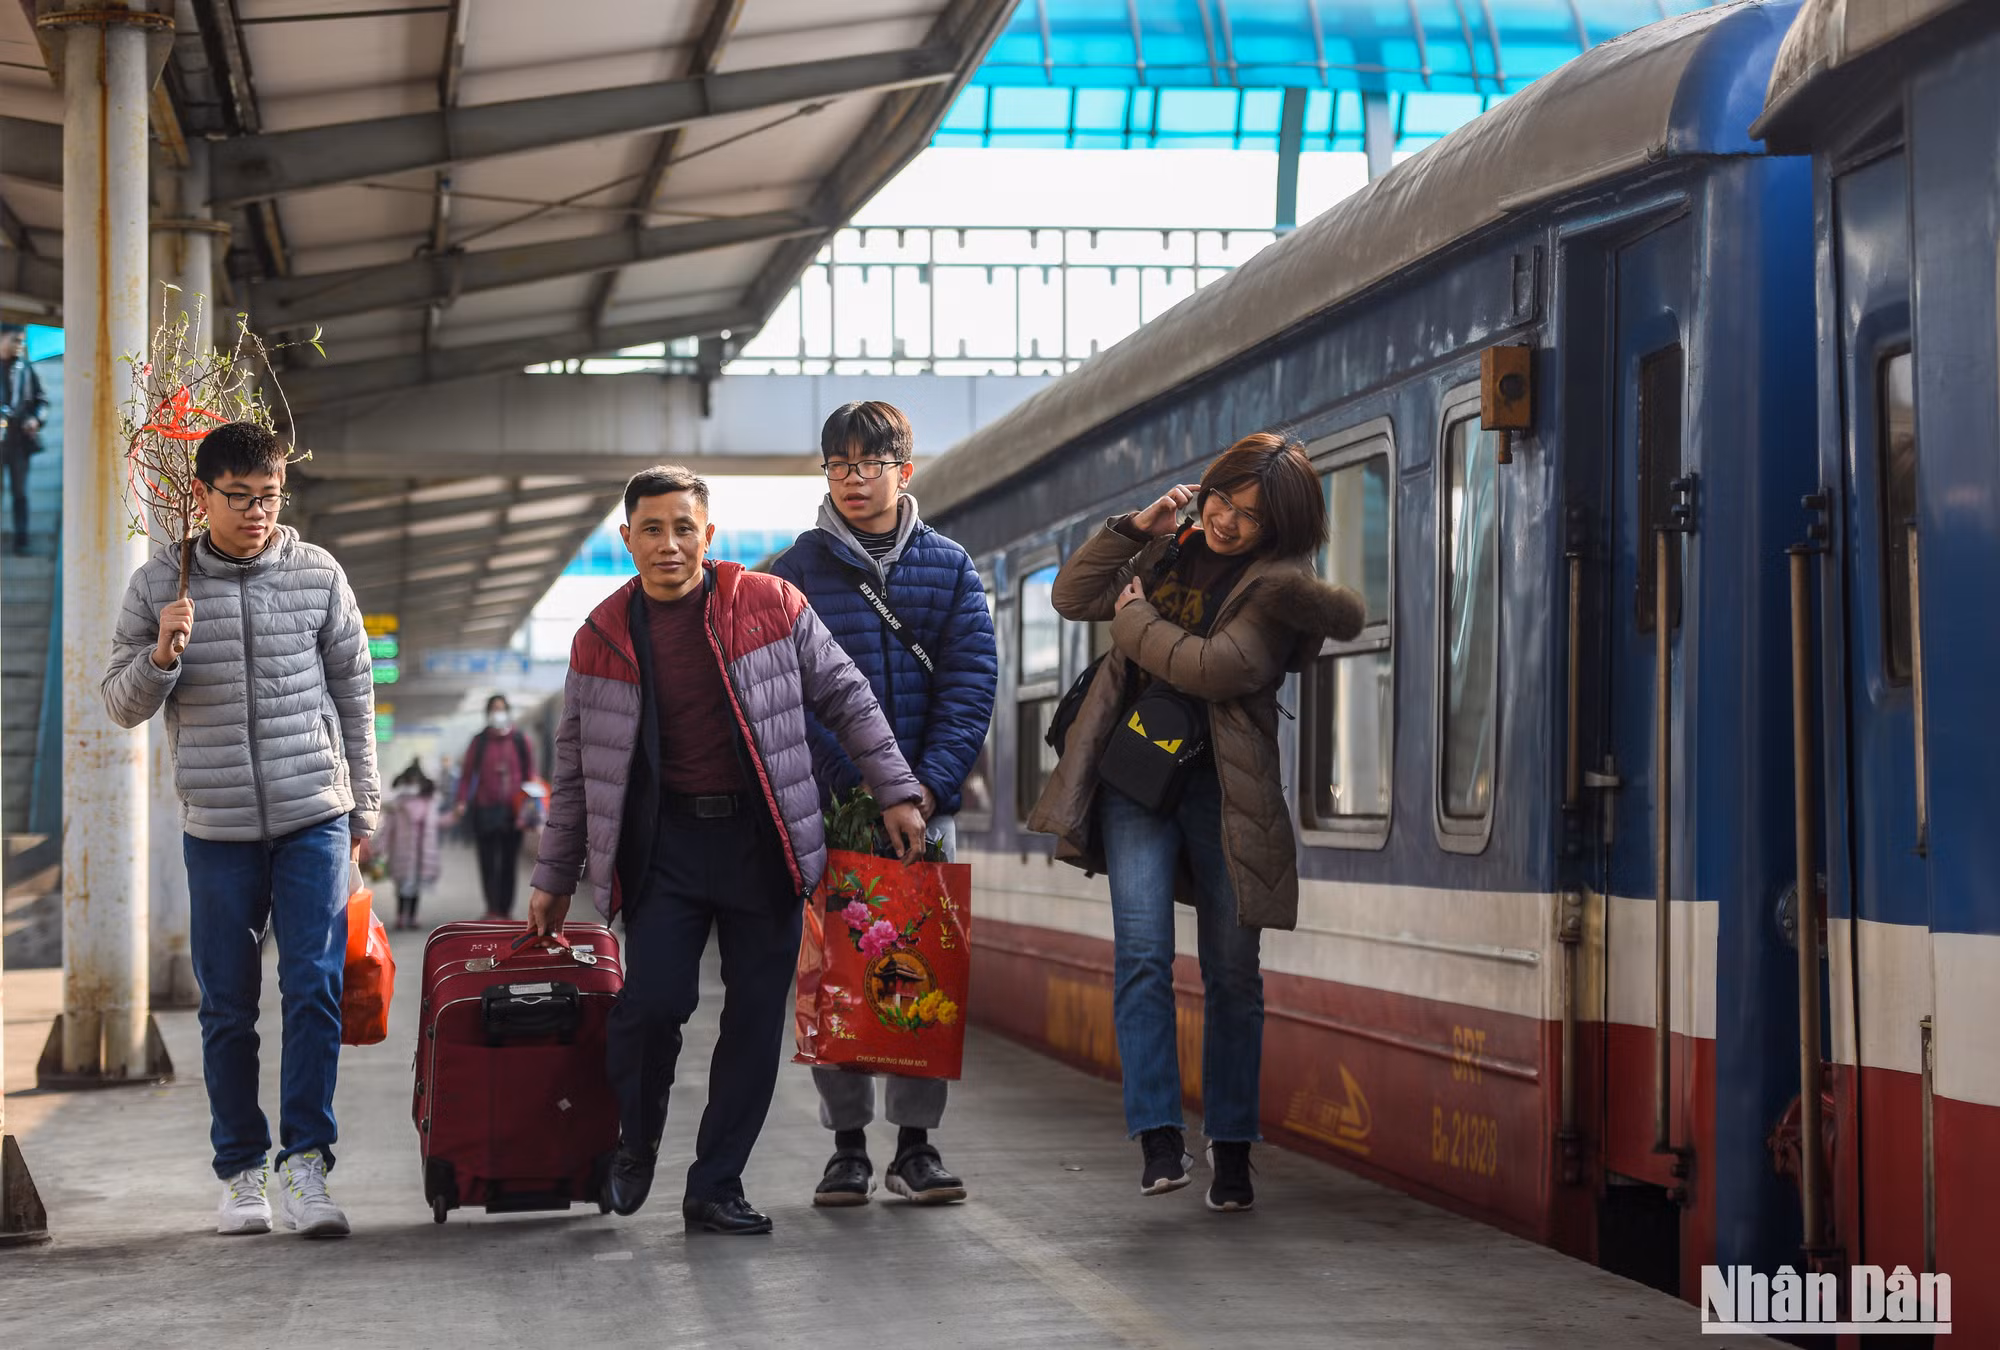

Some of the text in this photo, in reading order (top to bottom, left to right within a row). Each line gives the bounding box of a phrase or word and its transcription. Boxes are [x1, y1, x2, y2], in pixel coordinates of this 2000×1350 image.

[860, 582, 902, 630] SKYWALKER
[1453, 1024, 1486, 1085] SRT
[1452, 1110, 1497, 1177] 21328
